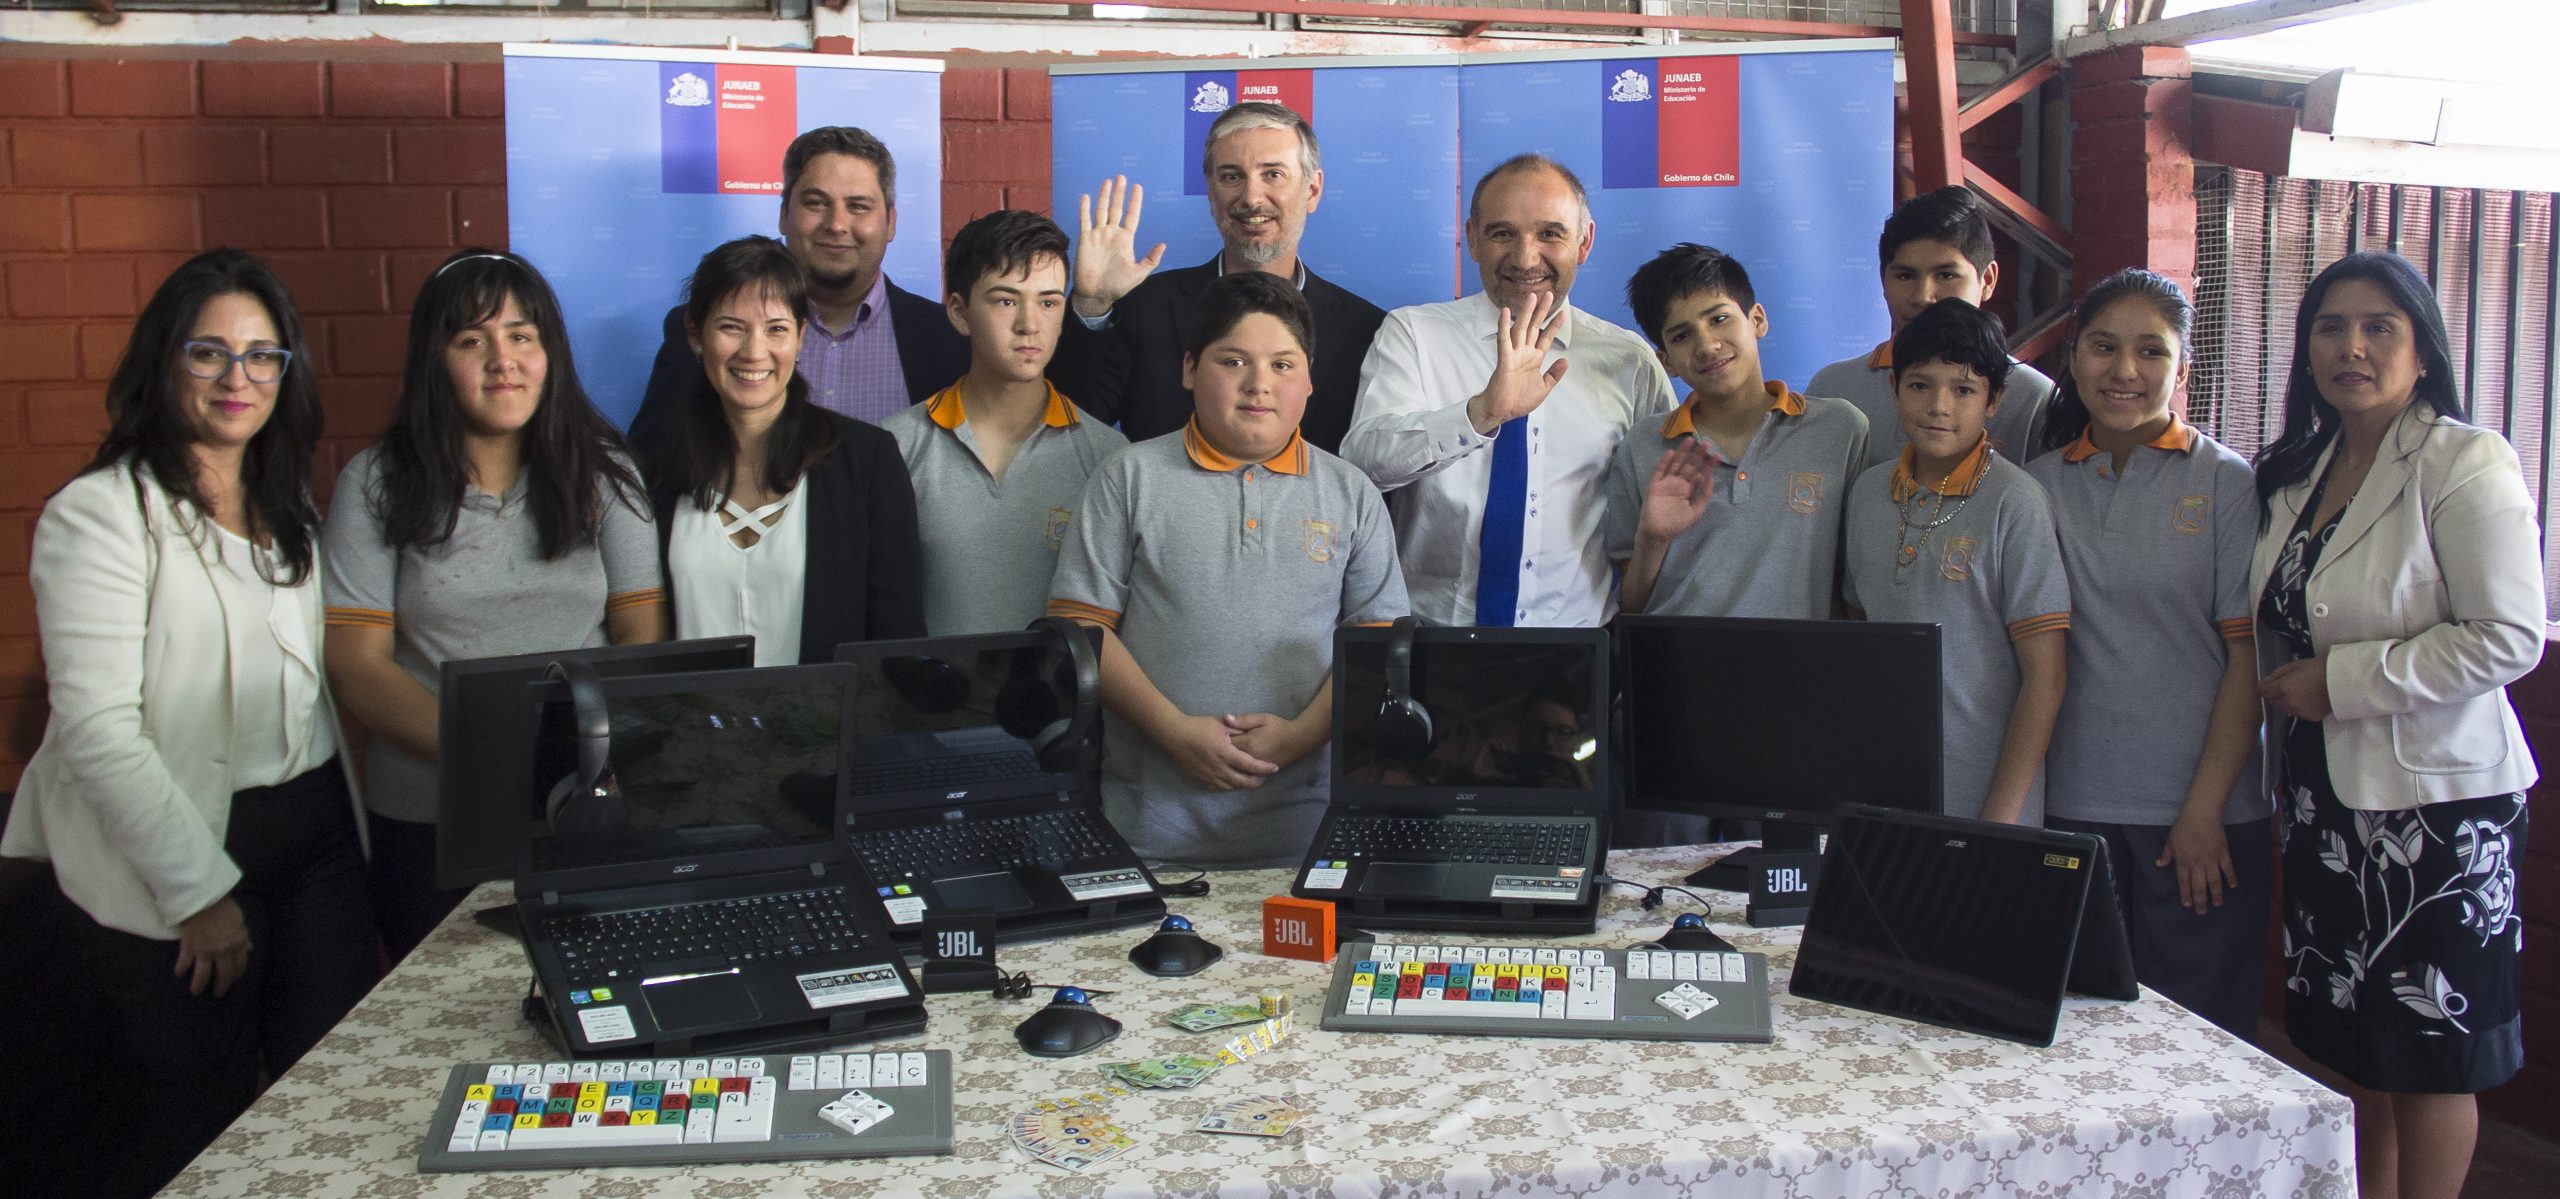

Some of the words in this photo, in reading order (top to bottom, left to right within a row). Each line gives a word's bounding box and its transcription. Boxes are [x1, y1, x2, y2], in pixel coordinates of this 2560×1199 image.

[1664, 73, 1702, 83] JUNAEB
[722, 80, 760, 91] JUNAEB
[1242, 86, 1278, 95] JUNAEB
[1663, 174, 1700, 182] Gobierno
[1714, 173, 1735, 181] Chile
[724, 181, 760, 190] Gobierno
[761, 182, 772, 190] de
[673, 864, 699, 873] acer
[1767, 868, 1807, 893] JBL
[1274, 918, 1313, 946] JBL
[938, 931, 983, 958] JBL
[501, 1087, 513, 1095] B
[529, 1086, 541, 1094] C
[586, 1084, 597, 1092] E
[615, 1083, 626, 1091] F
[642, 1082, 655, 1091] G
[729, 1080, 737, 1088] J
[466, 1103, 480, 1111] K
[523, 1101, 538, 1109] M
[553, 1100, 567, 1108] N
[611, 1098, 623, 1107] P
[639, 1097, 653, 1106] Q
[667, 1096, 680, 1105] R
[698, 1095, 709, 1104] S
[490, 1115, 502, 1124] T
[520, 1116, 533, 1125] U
[578, 1114, 593, 1123] W
[607, 1114, 622, 1122] X
[637, 1113, 649, 1121] Y
[665, 1111, 678, 1120] Z
